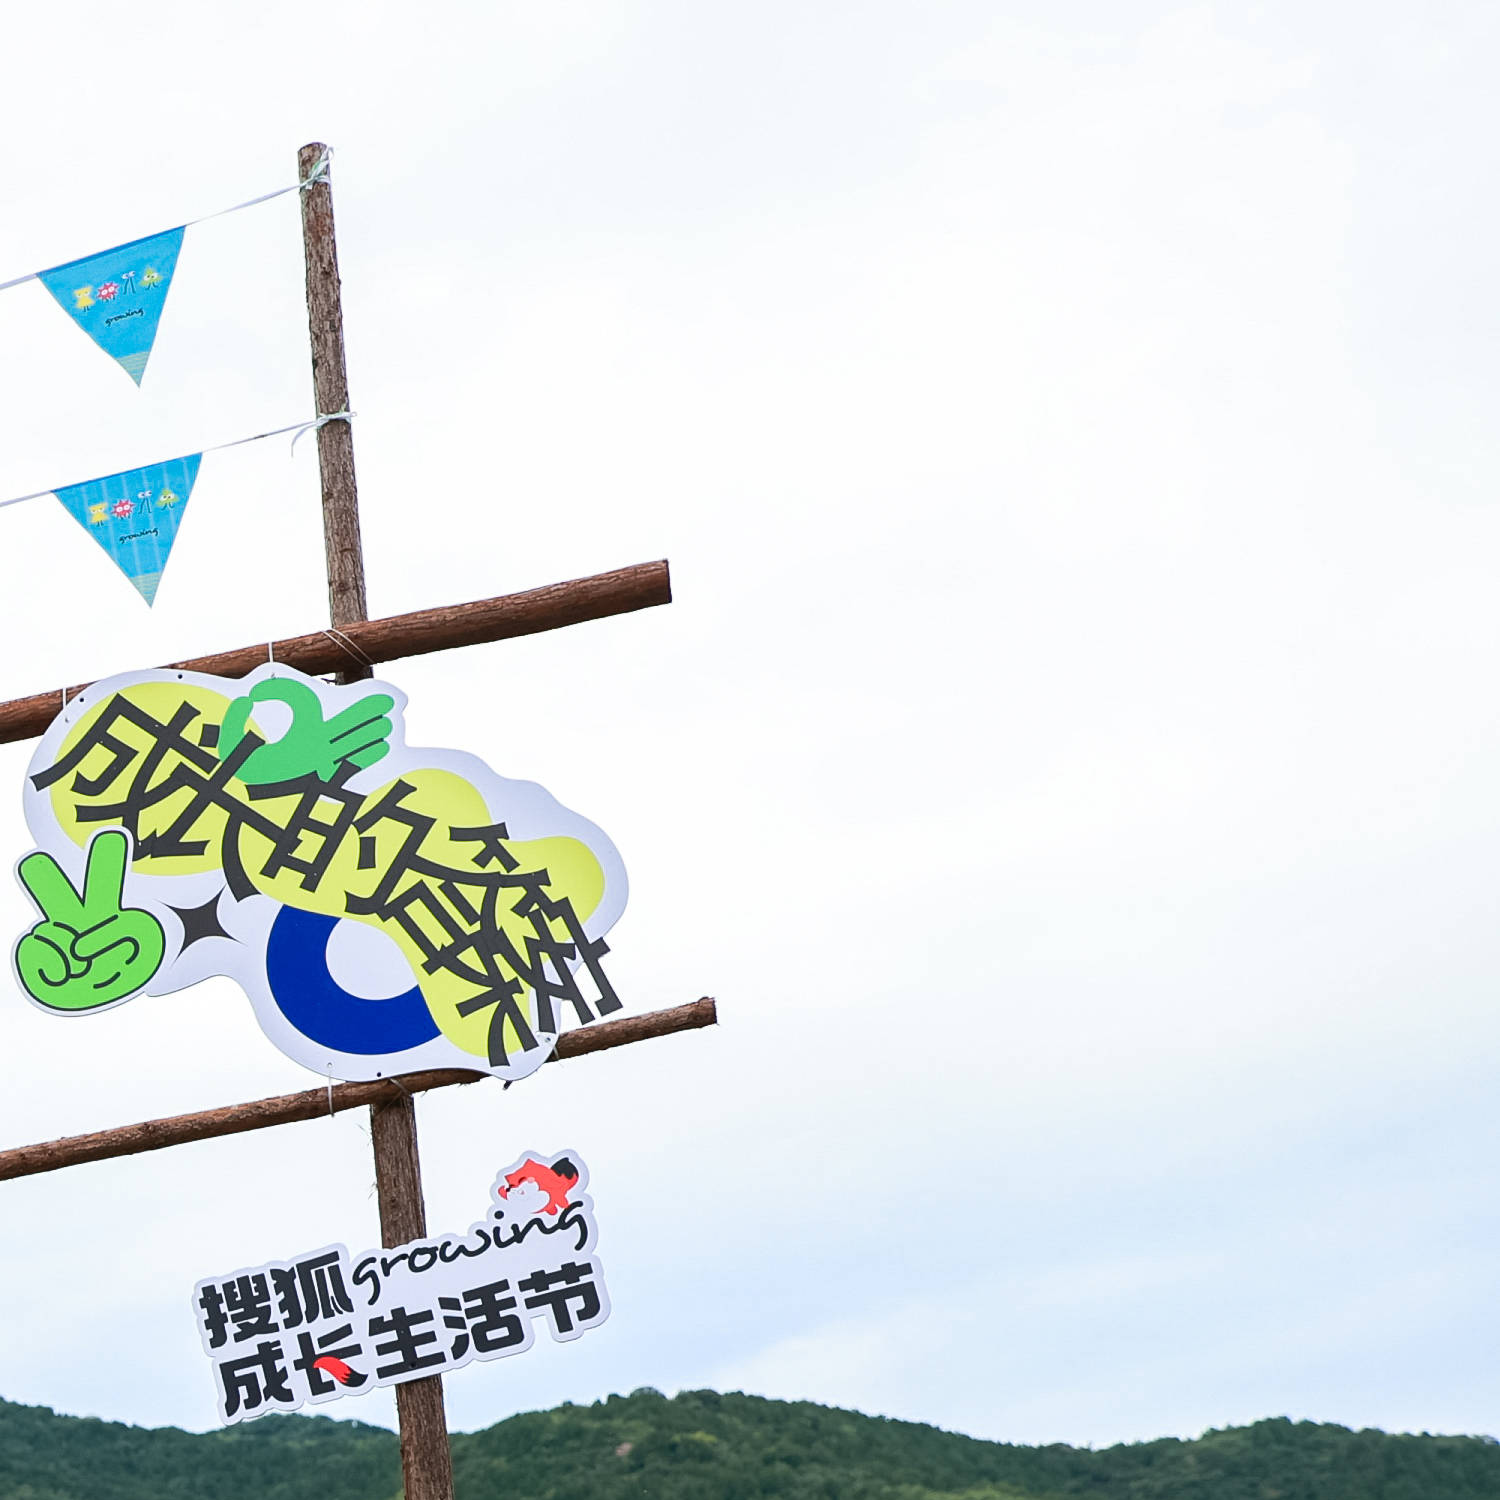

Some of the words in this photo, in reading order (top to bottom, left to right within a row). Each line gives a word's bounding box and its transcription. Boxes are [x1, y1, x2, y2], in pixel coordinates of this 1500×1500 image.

[105, 307, 145, 328] growing
[119, 527, 159, 544] growing
[30, 692, 624, 1067] 成长的答案
[200, 1251, 355, 1349] 搜狐
[352, 1201, 587, 1306] growing
[219, 1261, 601, 1418] 成长生活节
